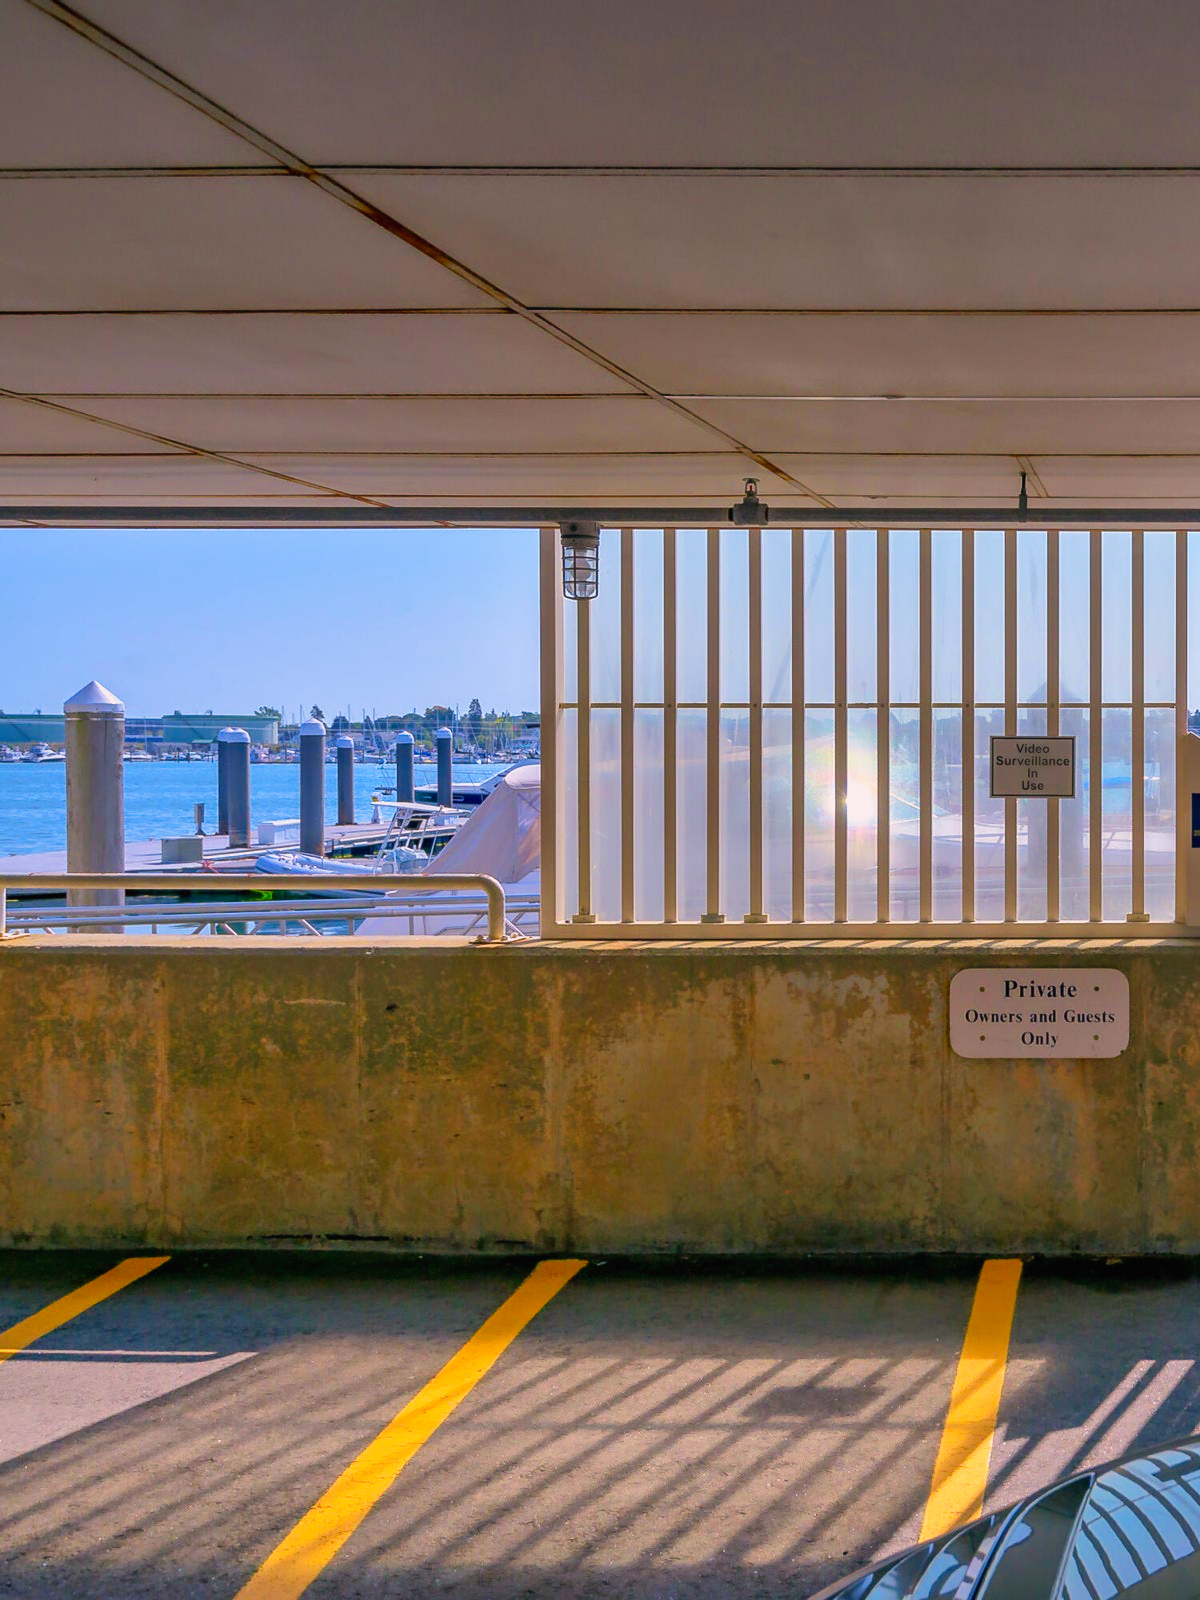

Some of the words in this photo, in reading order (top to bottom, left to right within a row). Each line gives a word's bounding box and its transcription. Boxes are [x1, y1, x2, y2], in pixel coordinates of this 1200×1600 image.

[1016, 743, 1050, 754] Video
[996, 756, 1070, 766] Surveillance
[1027, 768, 1038, 778] In
[1021, 780, 1044, 791] Use
[1003, 980, 1077, 998] Private
[965, 1009, 1023, 1023] Owners
[1029, 1009, 1057, 1023] and
[1063, 1009, 1115, 1023] Guests
[1021, 1031, 1059, 1048] Only
